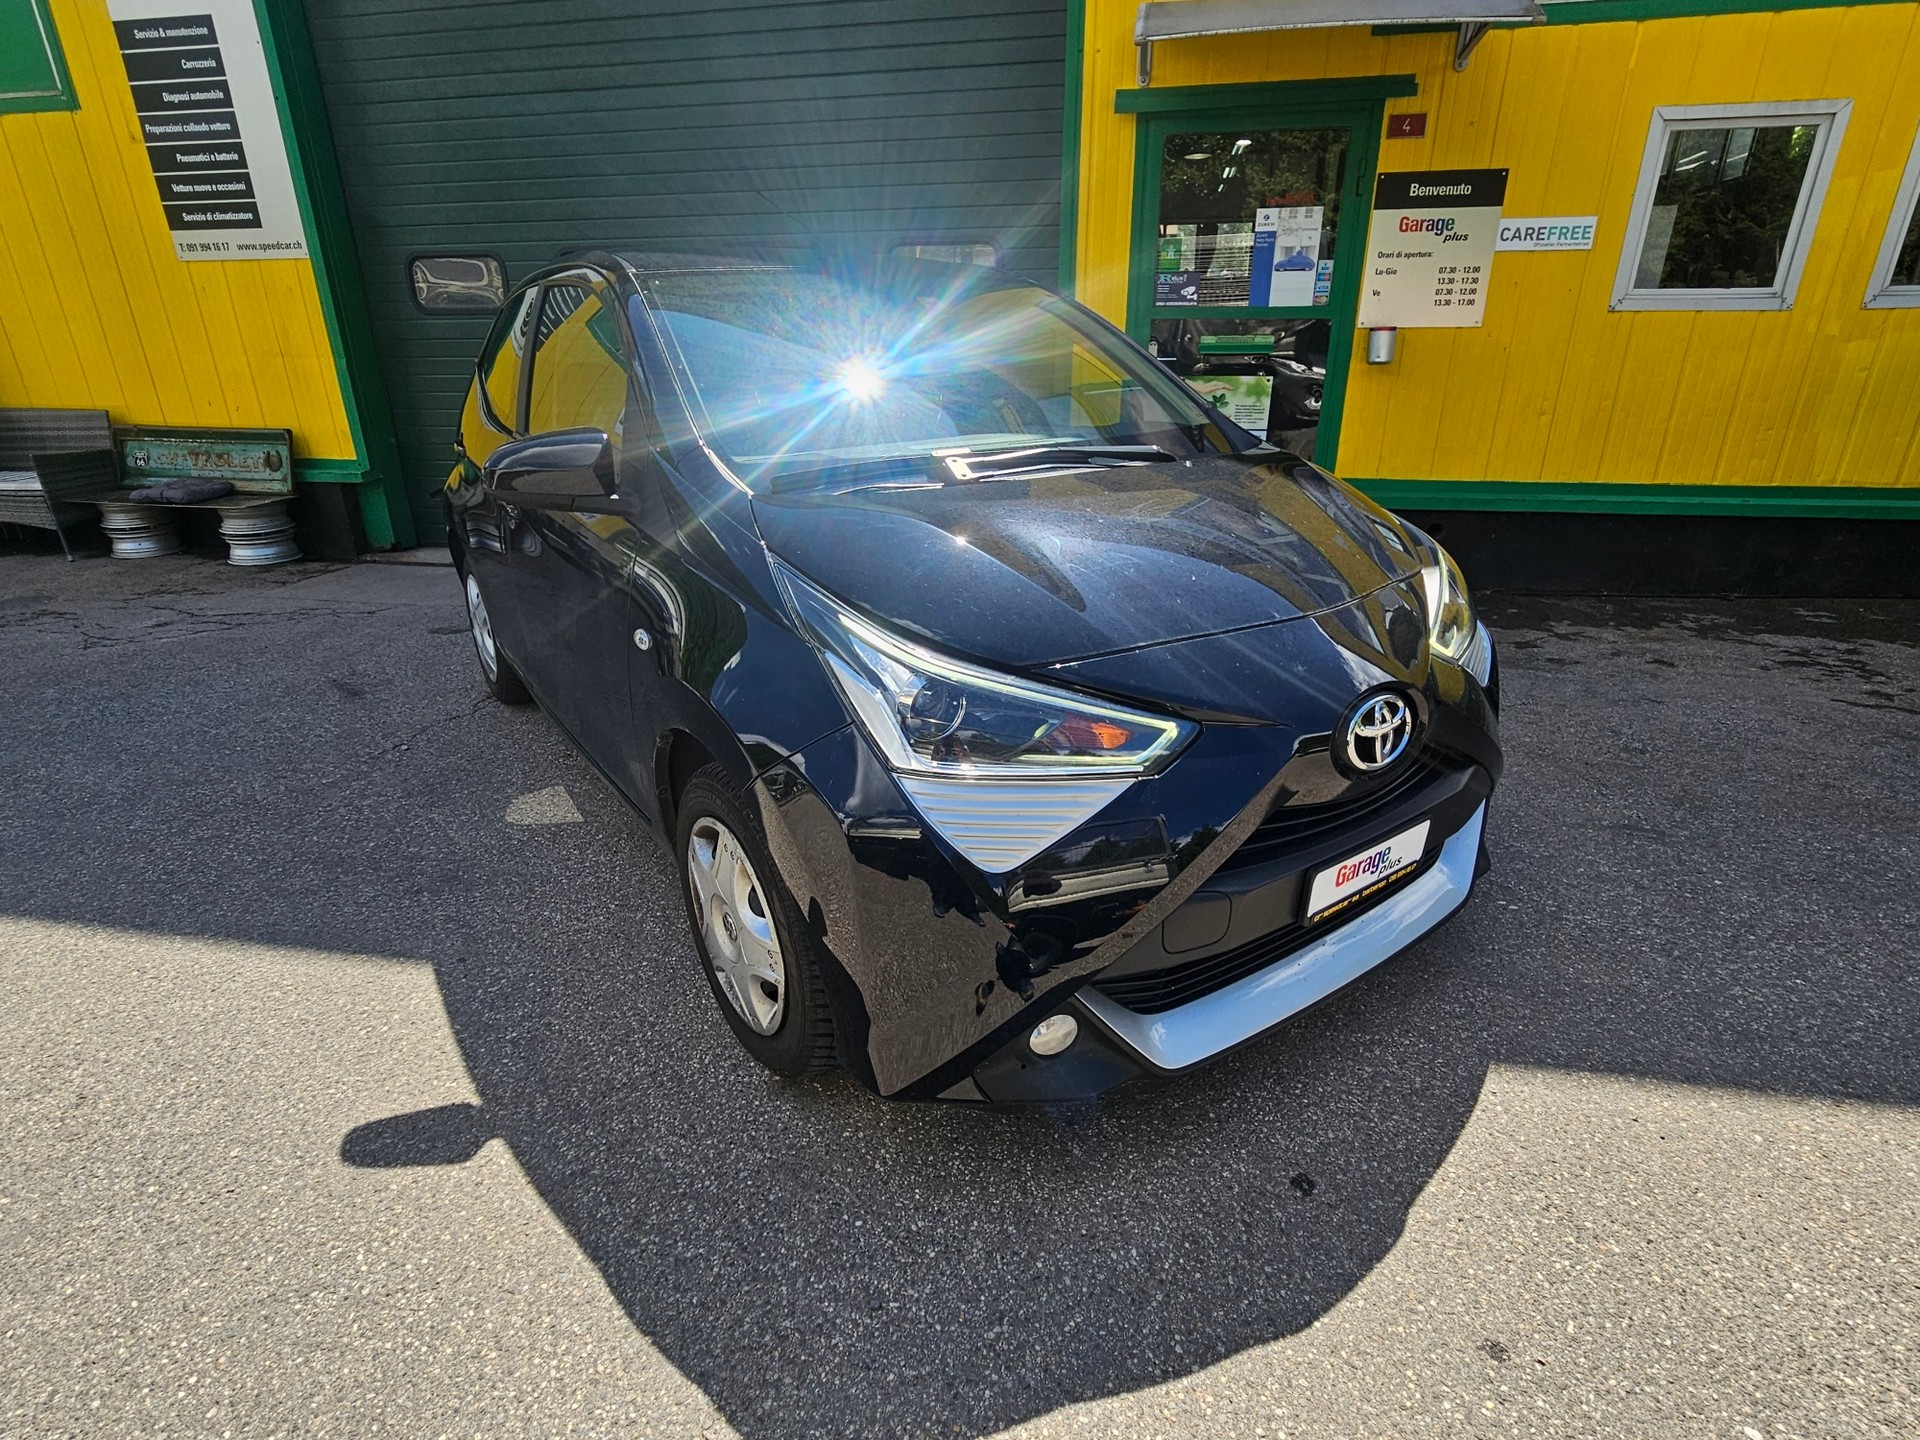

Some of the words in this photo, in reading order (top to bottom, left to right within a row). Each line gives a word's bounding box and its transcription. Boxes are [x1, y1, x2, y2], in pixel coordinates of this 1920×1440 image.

[134, 27, 159, 40] Servizio
[159, 26, 166, 38] &
[166, 26, 208, 38] manutenzione
[181, 58, 217, 70] Carrozzeria
[162, 91, 190, 104] Diagnosi
[190, 90, 224, 102] automobile
[145, 123, 183, 135] Preparazioni
[183, 122, 209, 133] collaudo
[209, 122, 231, 132] vetture
[1402, 119, 1411, 133] 4
[176, 152, 211, 164] Pneumatici
[215, 151, 239, 162] batterie
[171, 183, 193, 193] Vetture
[193, 184, 212, 193] nuove
[217, 182, 246, 192] occasioni
[1409, 183, 1472, 197] Benvenuto
[182, 212, 206, 222] Servizio
[206, 211, 213, 221] di
[213, 211, 253, 221] climatizzatore
[1398, 216, 1456, 236] Garage
[1442, 232, 1469, 244] plus
[1500, 225, 1594, 242] CAREFREE
[178, 243, 186, 252] T:
[186, 243, 199, 252] 091
[199, 242, 212, 252] 994
[212, 242, 222, 252] 16
[222, 242, 230, 252] 17
[236, 240, 303, 253] www.speedcar.ch
[1377, 251, 1395, 259] Orari
[1395, 250, 1403, 259] di
[1403, 251, 1434, 260] apertura:
[1375, 267, 1398, 276] Lu-Gio
[1438, 266, 1457, 274] 07.30
[1463, 266, 1481, 274] 12.00
[1437, 277, 1455, 285] 13.30
[1461, 277, 1479, 285] 17.30
[1372, 289, 1381, 297] Ve
[1435, 288, 1453, 296] 07.30
[1459, 288, 1477, 296] 12.00
[1434, 299, 1451, 307] 13.30
[1457, 298, 1475, 306] 17.00
[1334, 846, 1392, 888] Garage
[1377, 857, 1403, 879] plus
